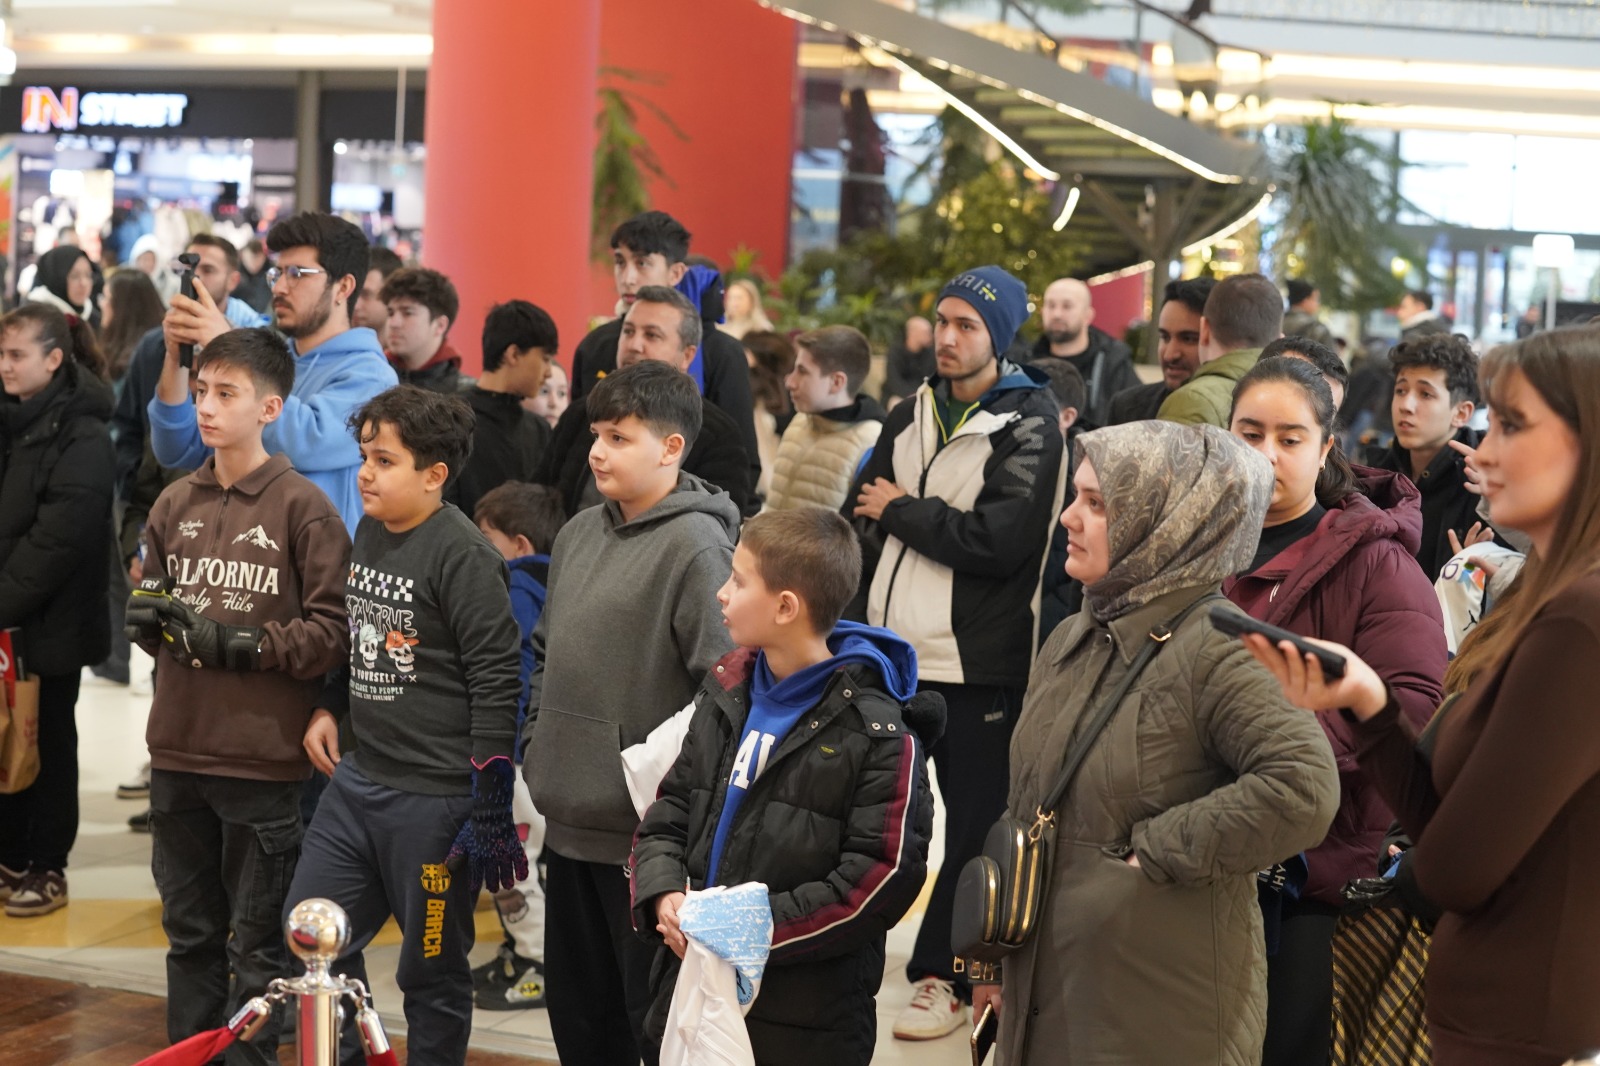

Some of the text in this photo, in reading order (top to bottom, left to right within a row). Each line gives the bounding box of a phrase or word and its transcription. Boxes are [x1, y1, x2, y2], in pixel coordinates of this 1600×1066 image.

[22, 86, 79, 132] IN
[357, 668, 396, 684] YOURSELF
[379, 686, 404, 695] PEOPLE
[422, 898, 446, 958] BARÇA
